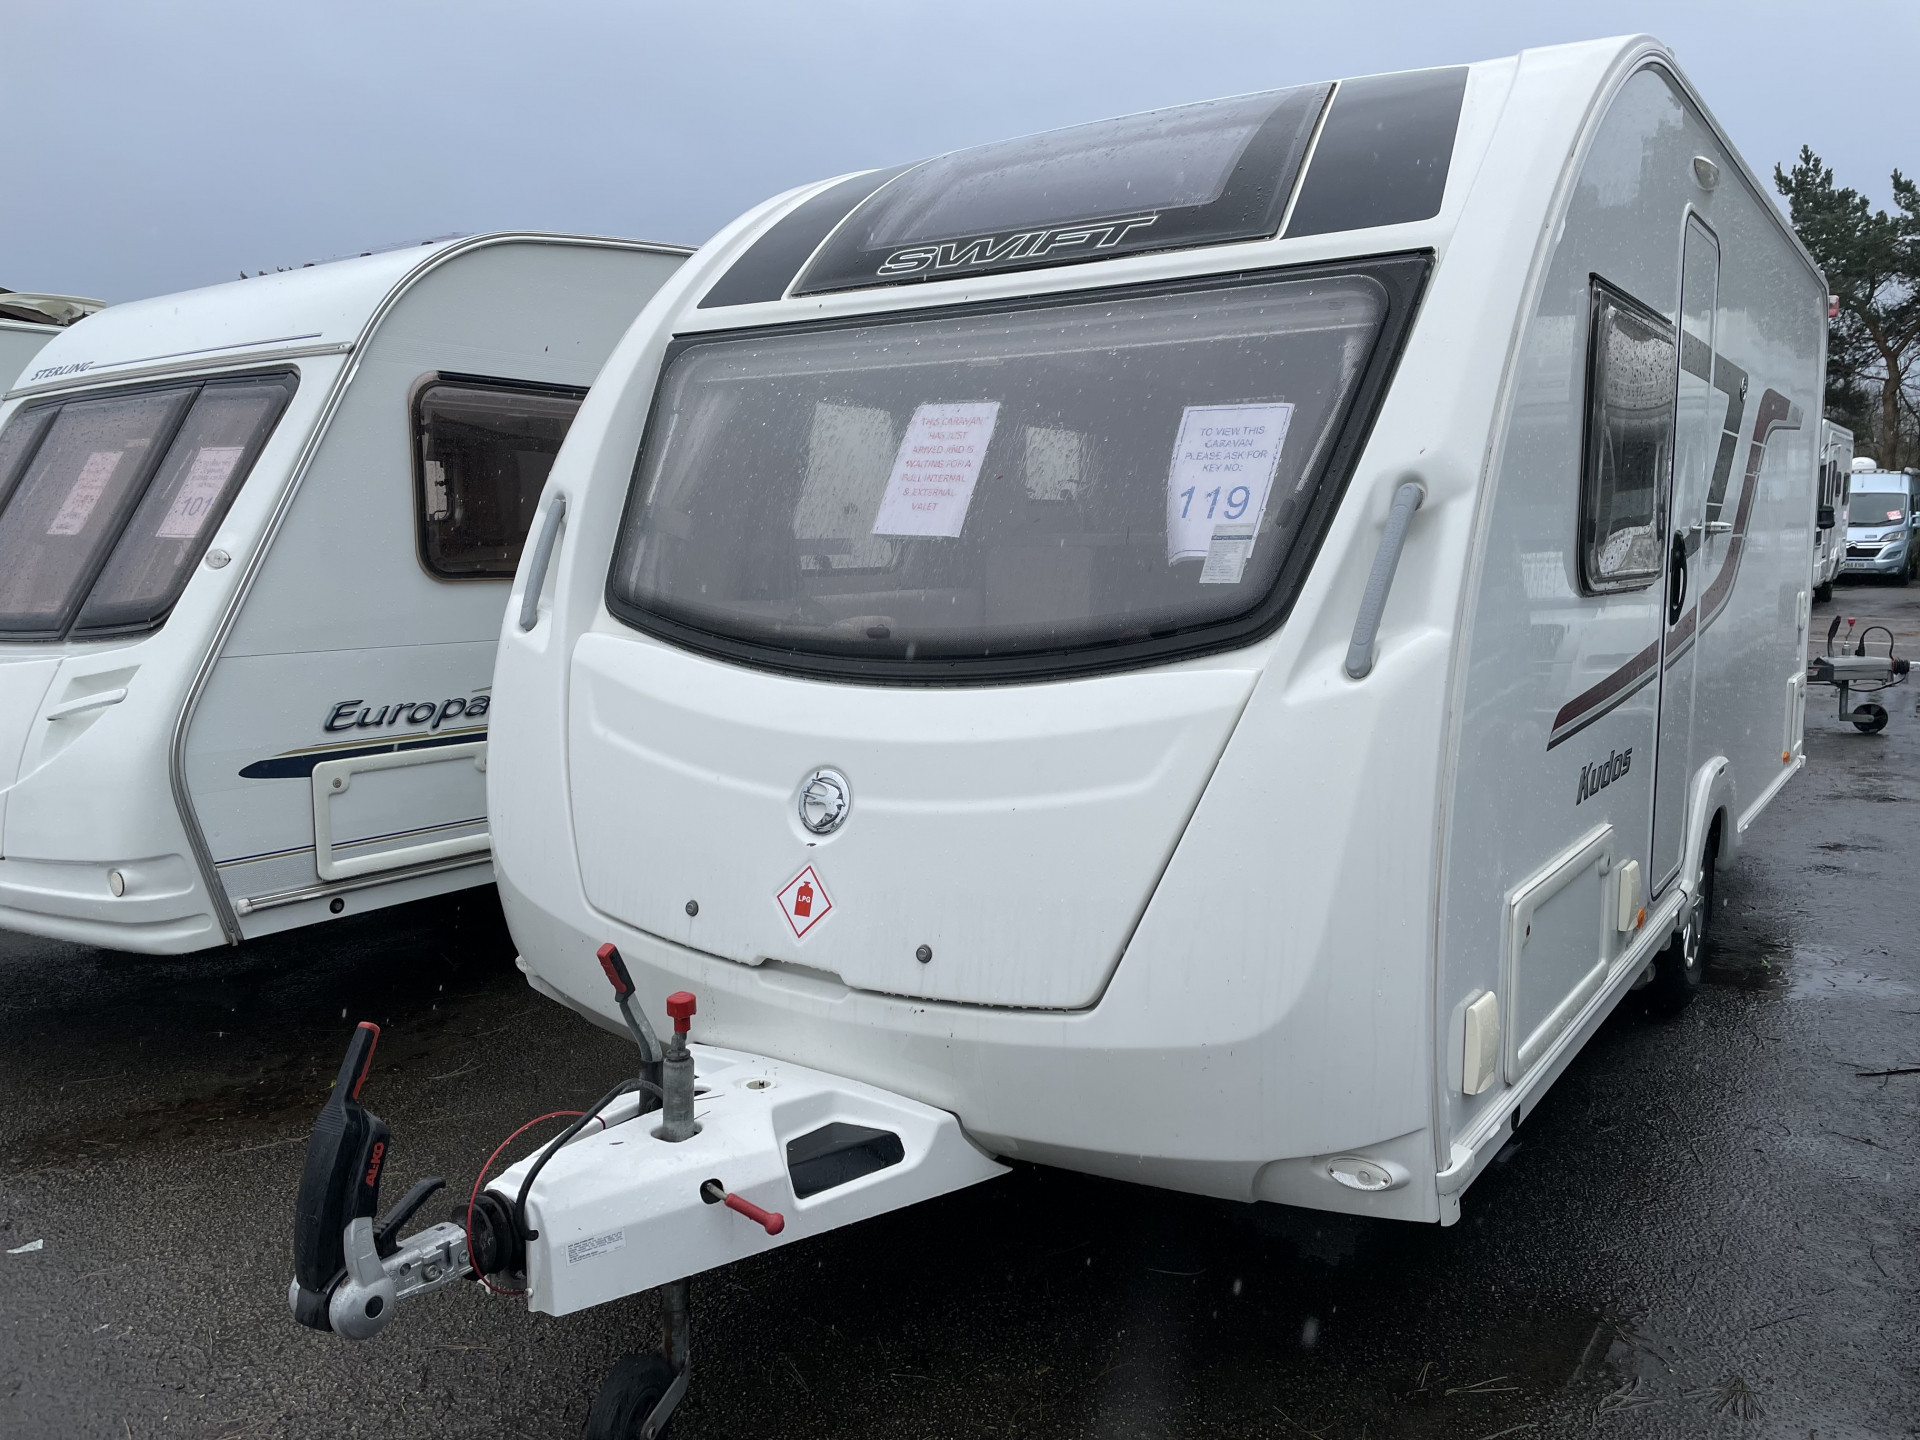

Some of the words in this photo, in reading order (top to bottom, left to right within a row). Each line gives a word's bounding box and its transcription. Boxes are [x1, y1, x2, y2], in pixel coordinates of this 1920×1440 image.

[876, 214, 1160, 276] SWIFT
[30, 360, 95, 381] STERLING
[941, 416, 983, 426] CARAVAN
[1200, 427, 1213, 436] TO
[1216, 427, 1241, 436] VIEW
[1243, 425, 1265, 435] THIS
[1204, 439, 1254, 448] CARAVAN
[1184, 451, 1222, 460] PLEASE
[1223, 451, 1246, 460] ASK
[1247, 449, 1268, 459] FOR
[905, 460, 945, 468] WAITING
[946, 460, 965, 468] FOR
[1202, 463, 1222, 473] KEY
[923, 474, 966, 483] INTERNAL
[902, 487, 909, 496] &
[911, 488, 956, 497] EXTERNAL
[181, 496, 214, 517] 101
[911, 502, 938, 511] VALET
[1180, 485, 1251, 520] 119
[323, 694, 491, 732] Europa
[1576, 747, 1633, 806] Kudos
[798, 894, 811, 903] LPG
